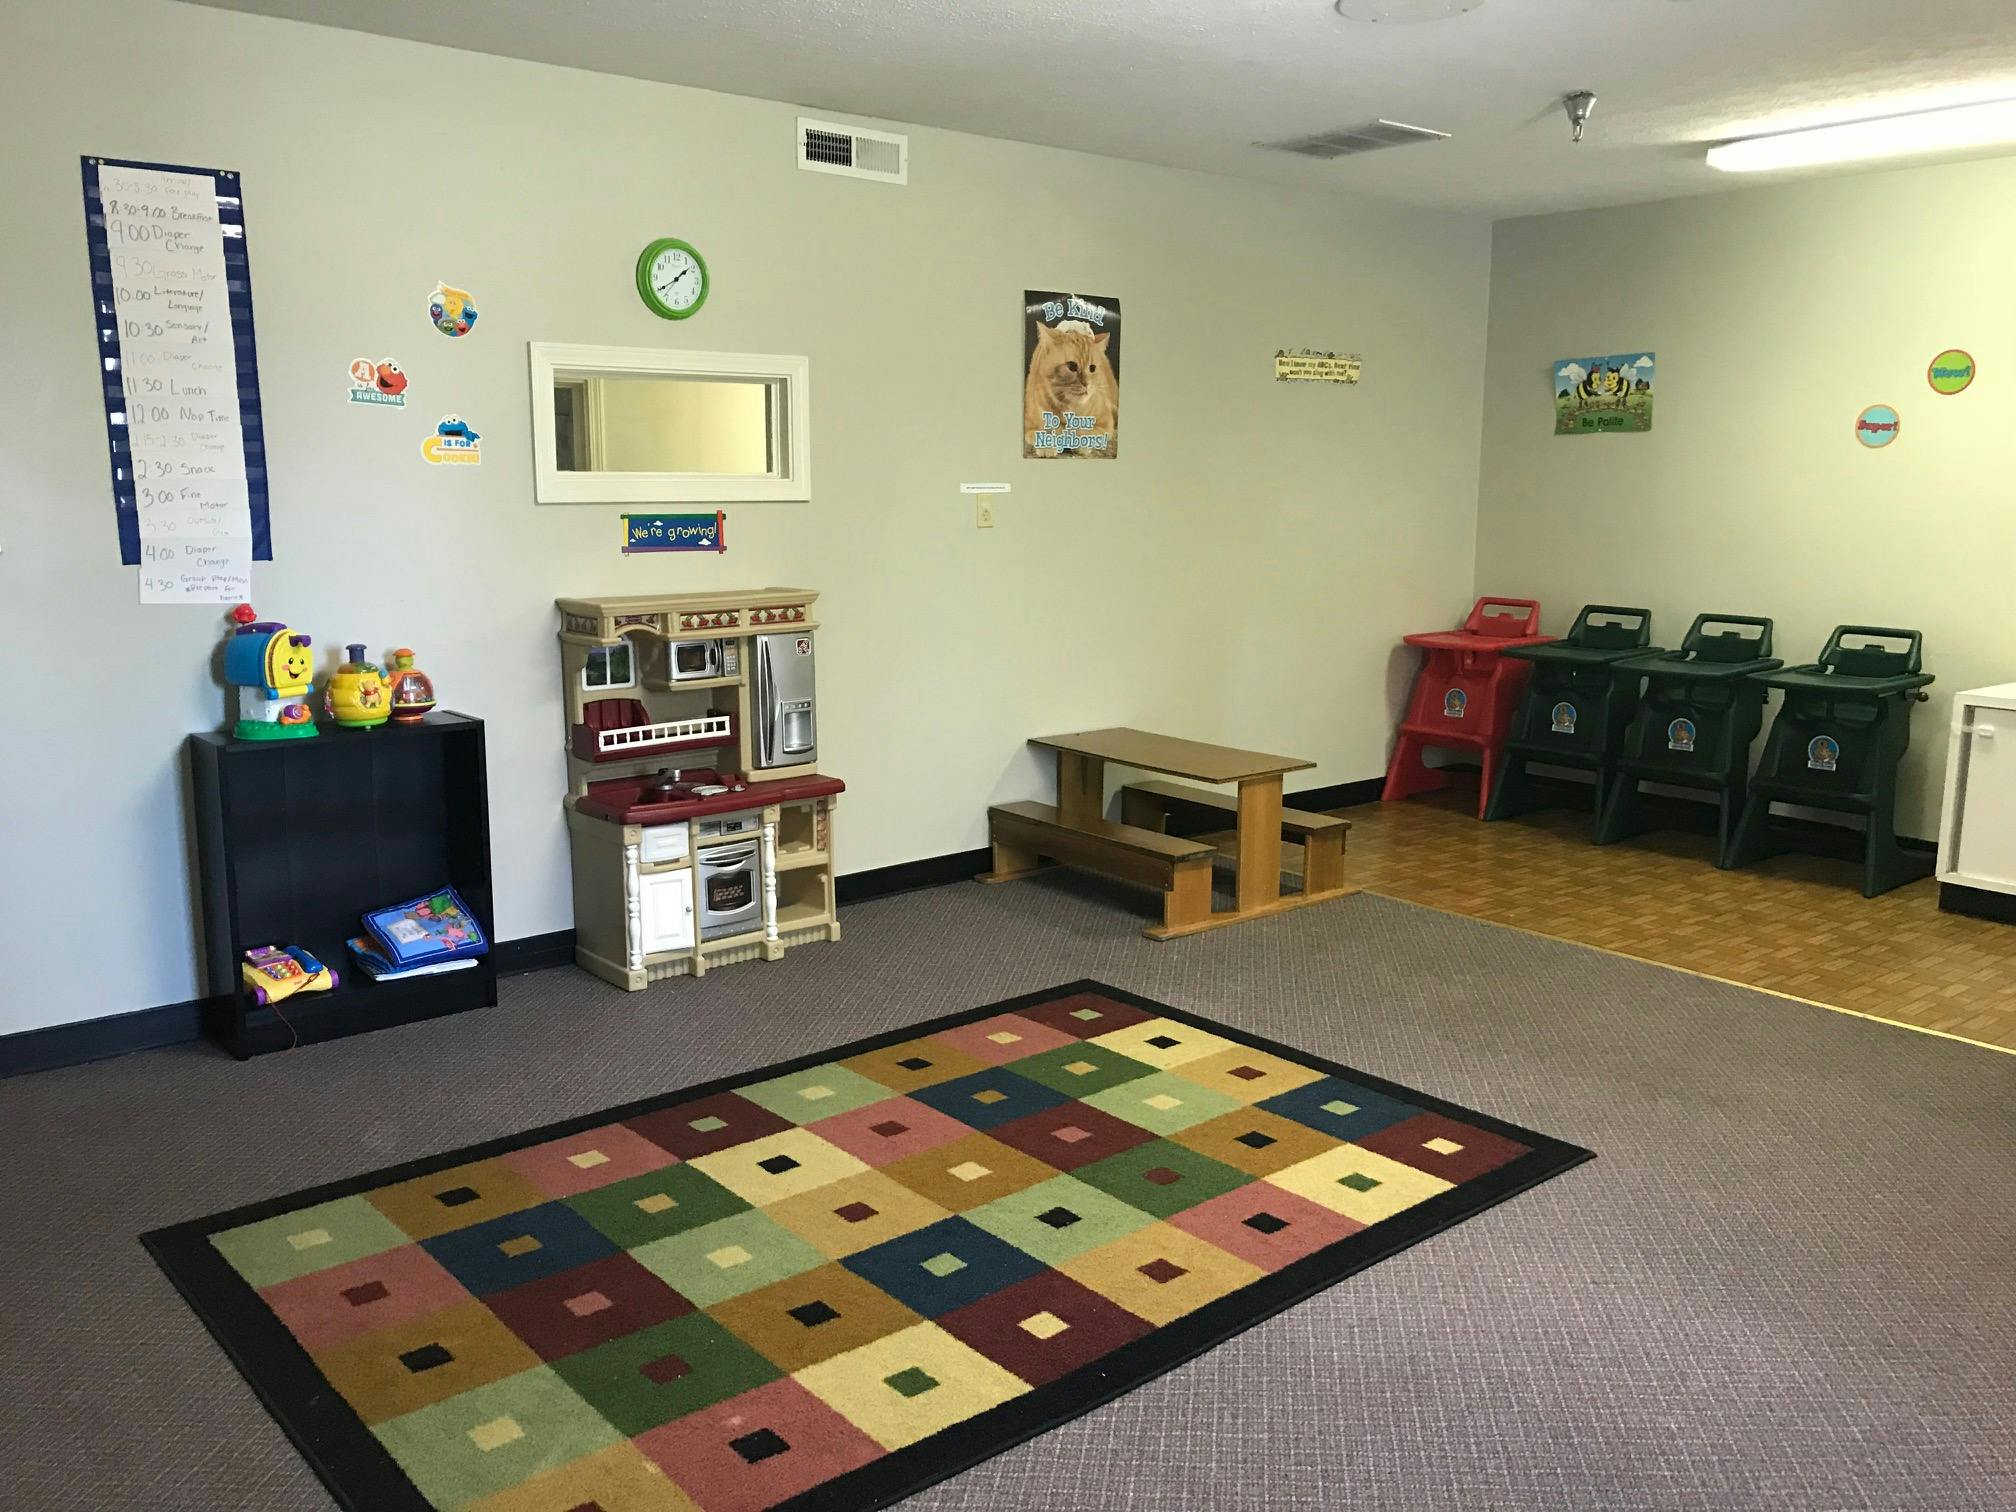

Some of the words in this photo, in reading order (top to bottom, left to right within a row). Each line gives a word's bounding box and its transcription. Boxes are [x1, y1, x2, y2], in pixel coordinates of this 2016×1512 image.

[151, 224, 191, 241] Diaper
[165, 238, 206, 254] Change
[1042, 302, 1064, 322] Be
[1067, 298, 1105, 327] Kind
[191, 335, 208, 344] Art
[170, 377, 207, 397] Lunch
[356, 391, 403, 404] AWESOME
[206, 409, 230, 423] Time
[1043, 412, 1060, 430] To
[1065, 413, 1097, 430] Your
[1582, 418, 1594, 427] Be
[1597, 416, 1624, 427] Polite
[444, 439, 452, 447] IS
[454, 439, 471, 448] FOR
[1034, 430, 1109, 453] Neighbors!
[180, 461, 216, 476] Snack
[180, 486, 202, 500] Fine
[632, 523, 663, 539] We're
[668, 521, 717, 541] growing!
[184, 544, 217, 557] Diaper
[196, 556, 230, 569] Change
